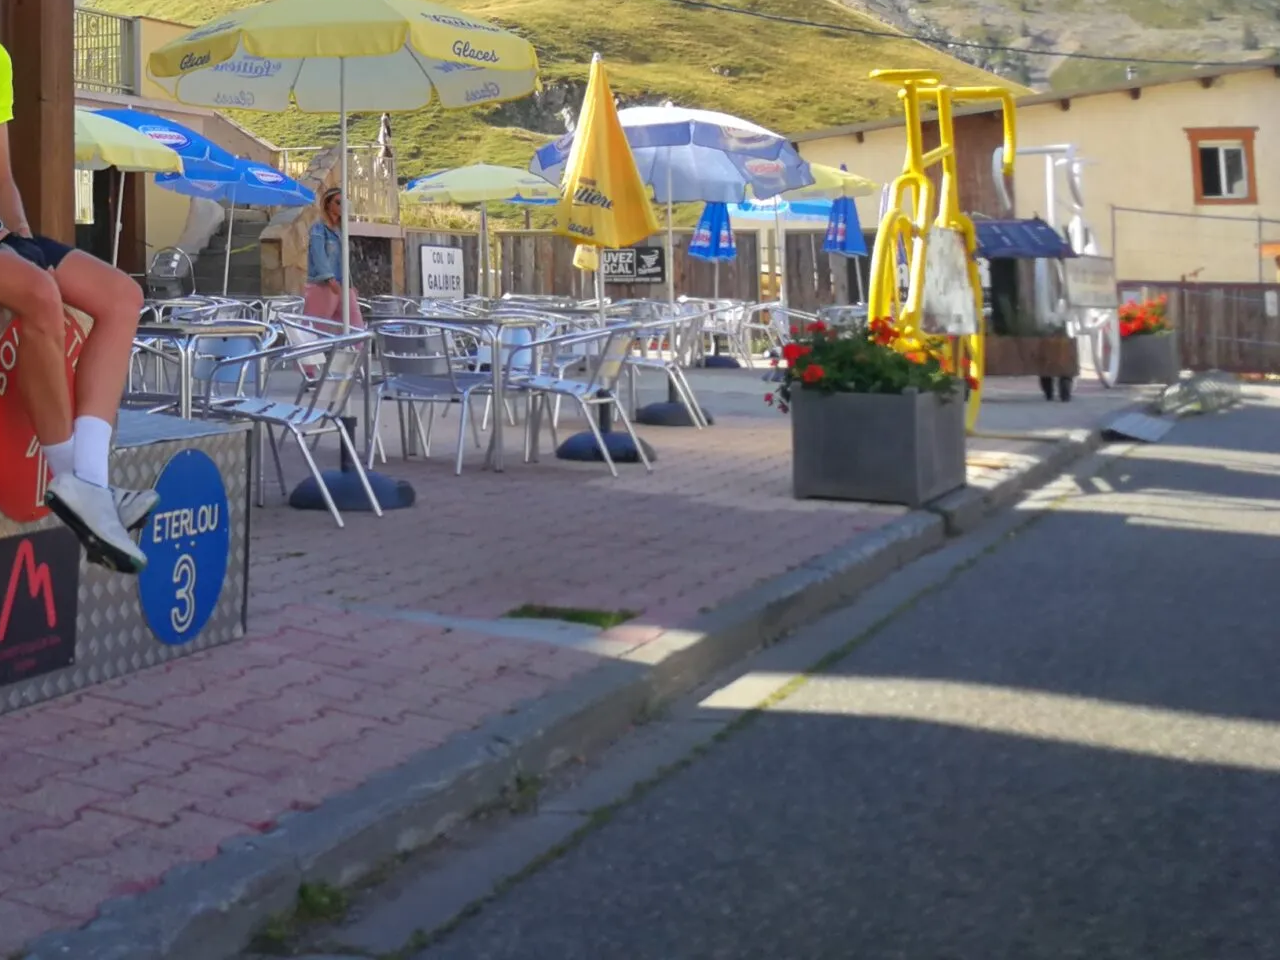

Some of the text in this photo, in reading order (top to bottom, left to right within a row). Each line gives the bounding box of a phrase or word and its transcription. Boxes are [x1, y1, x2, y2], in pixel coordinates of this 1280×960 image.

[180, 50, 211, 70] Glaces
[452, 40, 499, 62] Glaces
[568, 223, 595, 237] aces
[432, 251, 455, 265] COL DU
[604, 252, 633, 263] UVEZ
[603, 264, 632, 274] OCAL
[427, 273, 461, 291] GALIBIER
[153, 503, 219, 543] ETERLOU
[171, 554, 196, 633] 3
